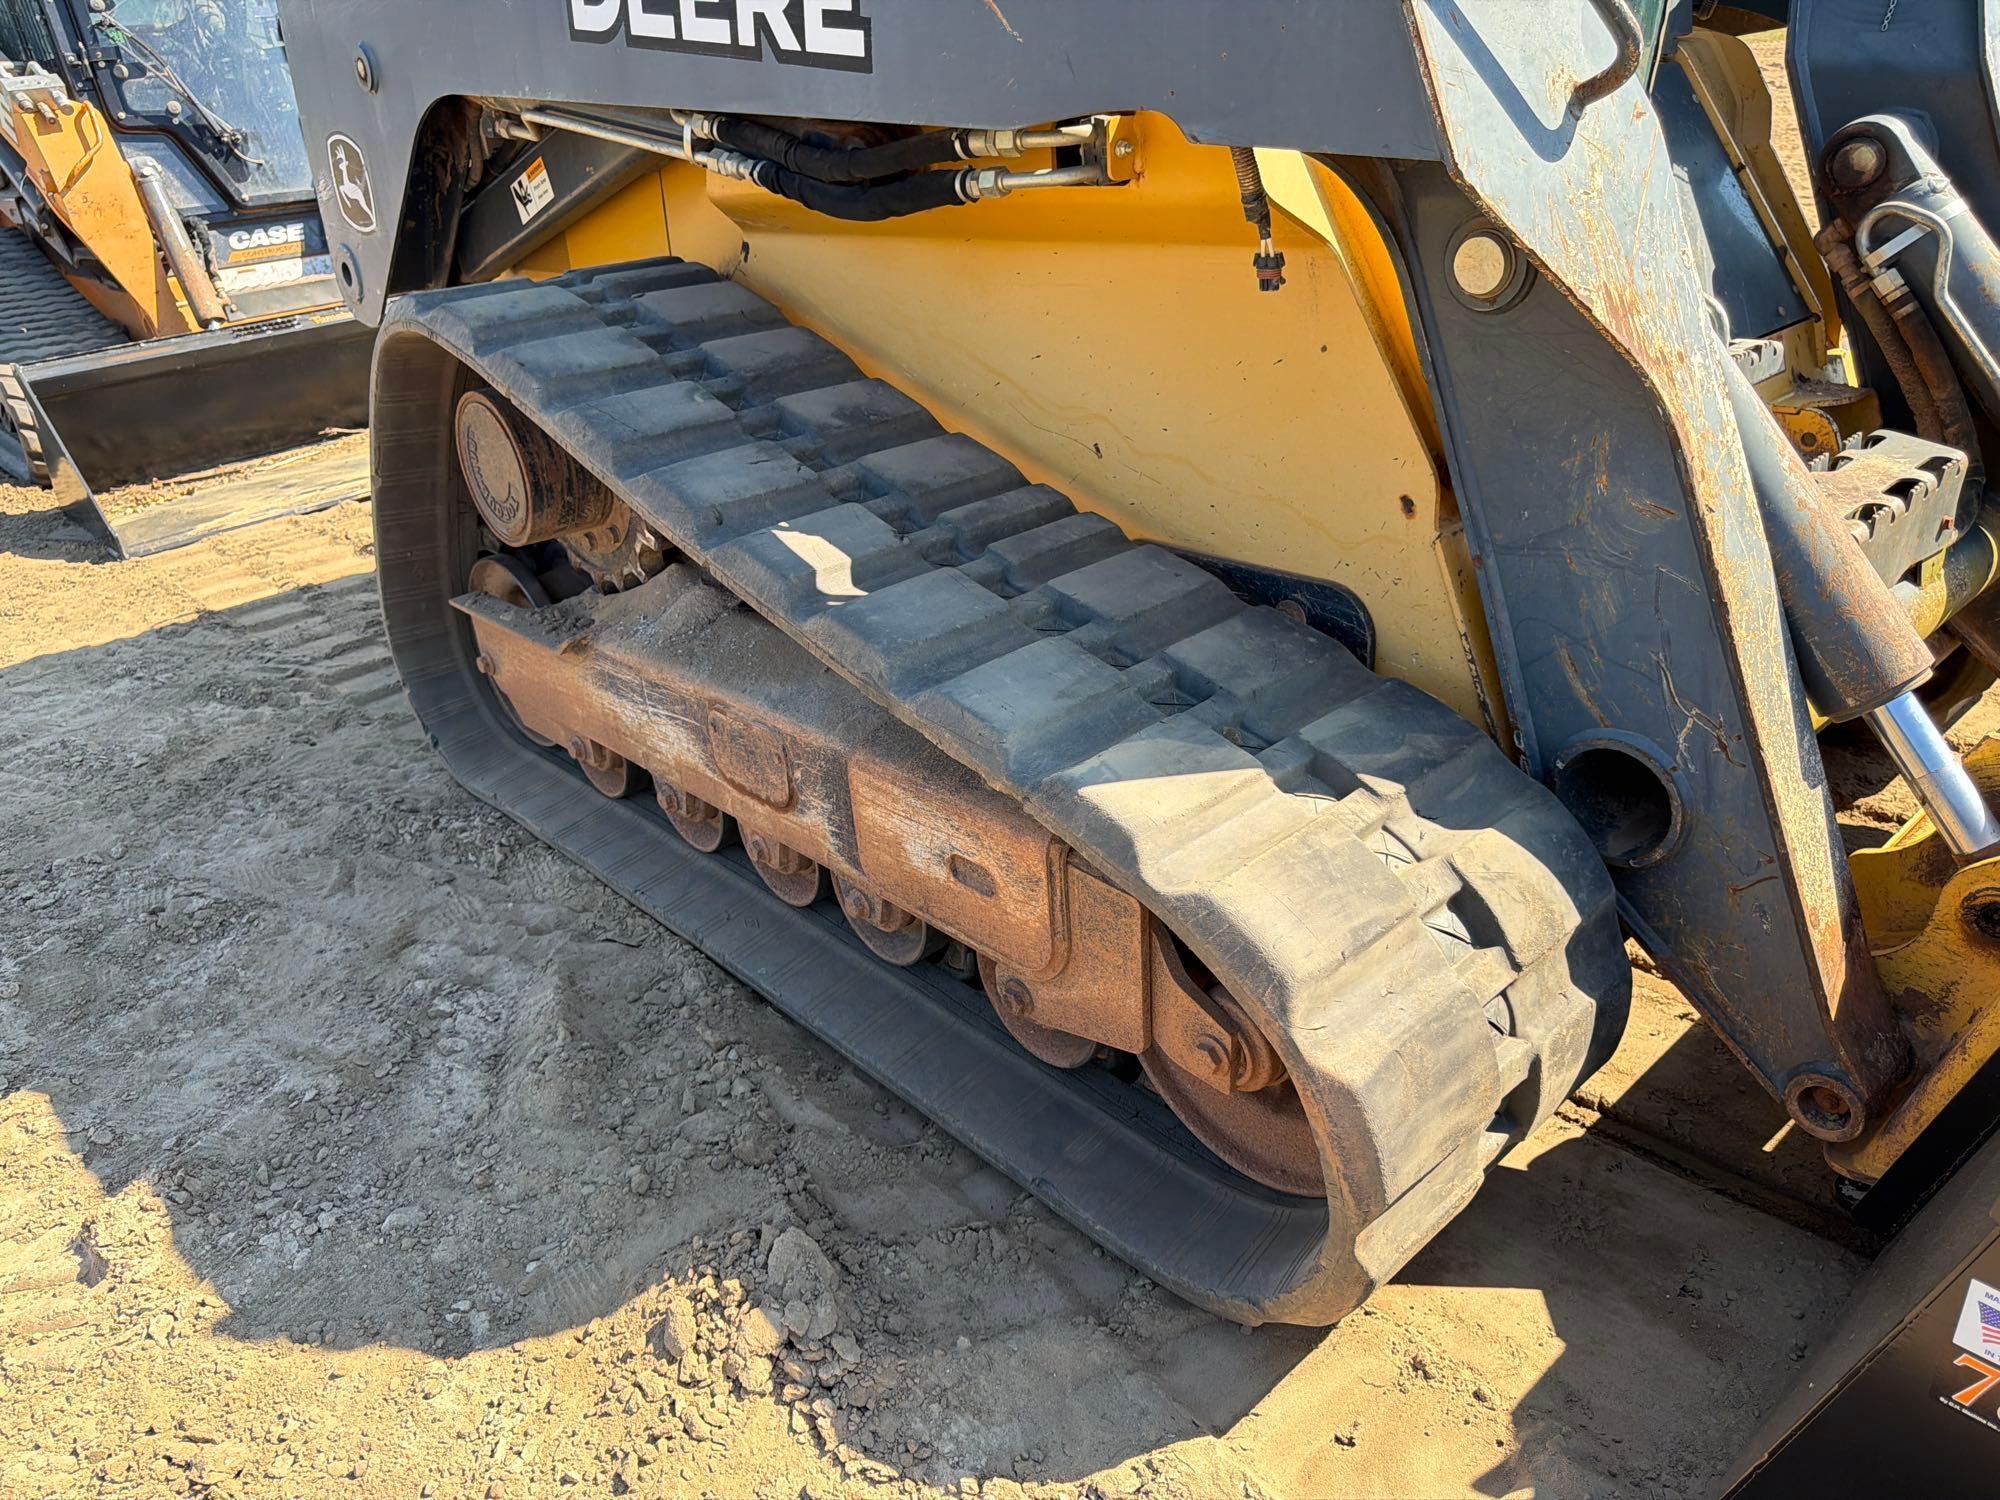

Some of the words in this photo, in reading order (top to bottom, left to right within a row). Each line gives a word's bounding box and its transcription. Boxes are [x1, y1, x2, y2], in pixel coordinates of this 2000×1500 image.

[572, 0, 864, 57] ERE
[229, 223, 305, 250] CASE
[1984, 1292, 2000, 1304] MA
